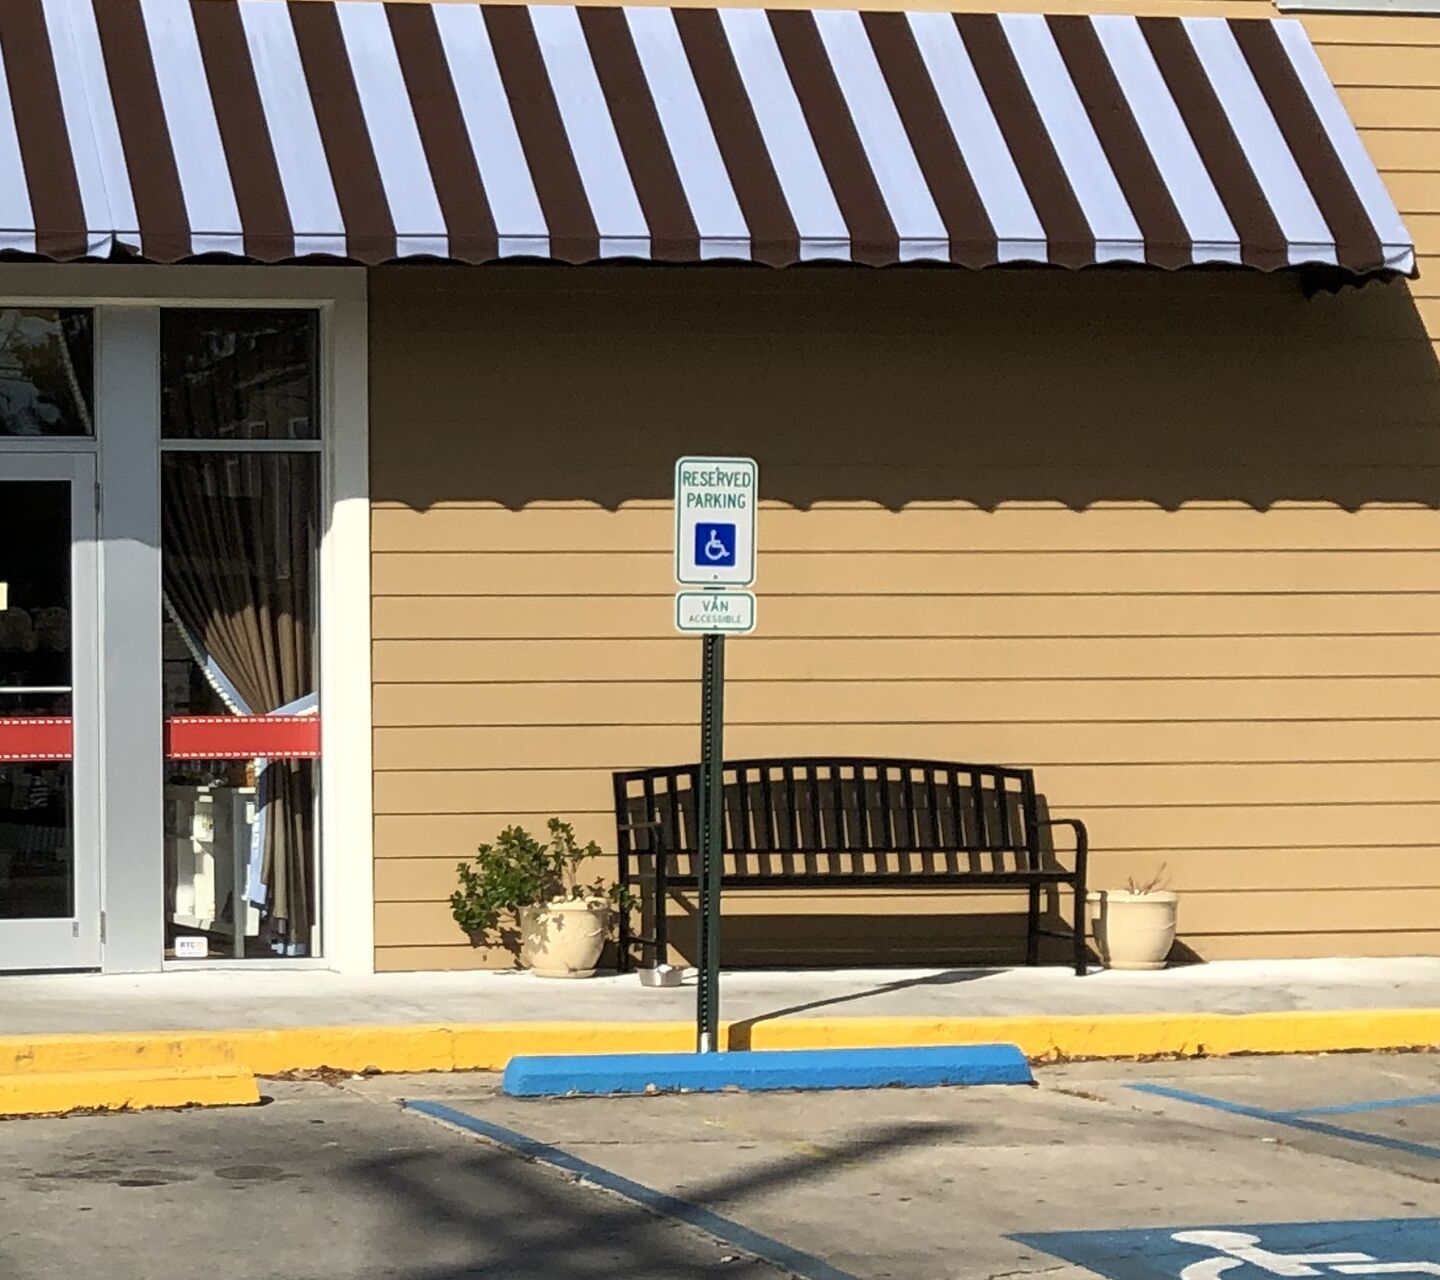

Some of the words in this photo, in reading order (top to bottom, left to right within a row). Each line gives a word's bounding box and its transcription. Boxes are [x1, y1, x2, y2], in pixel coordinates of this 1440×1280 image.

[682, 470, 751, 488] RESERVED
[685, 492, 747, 510] PARKING
[701, 599, 729, 613] VAN
[688, 614, 742, 624] ACCESSIBLE
